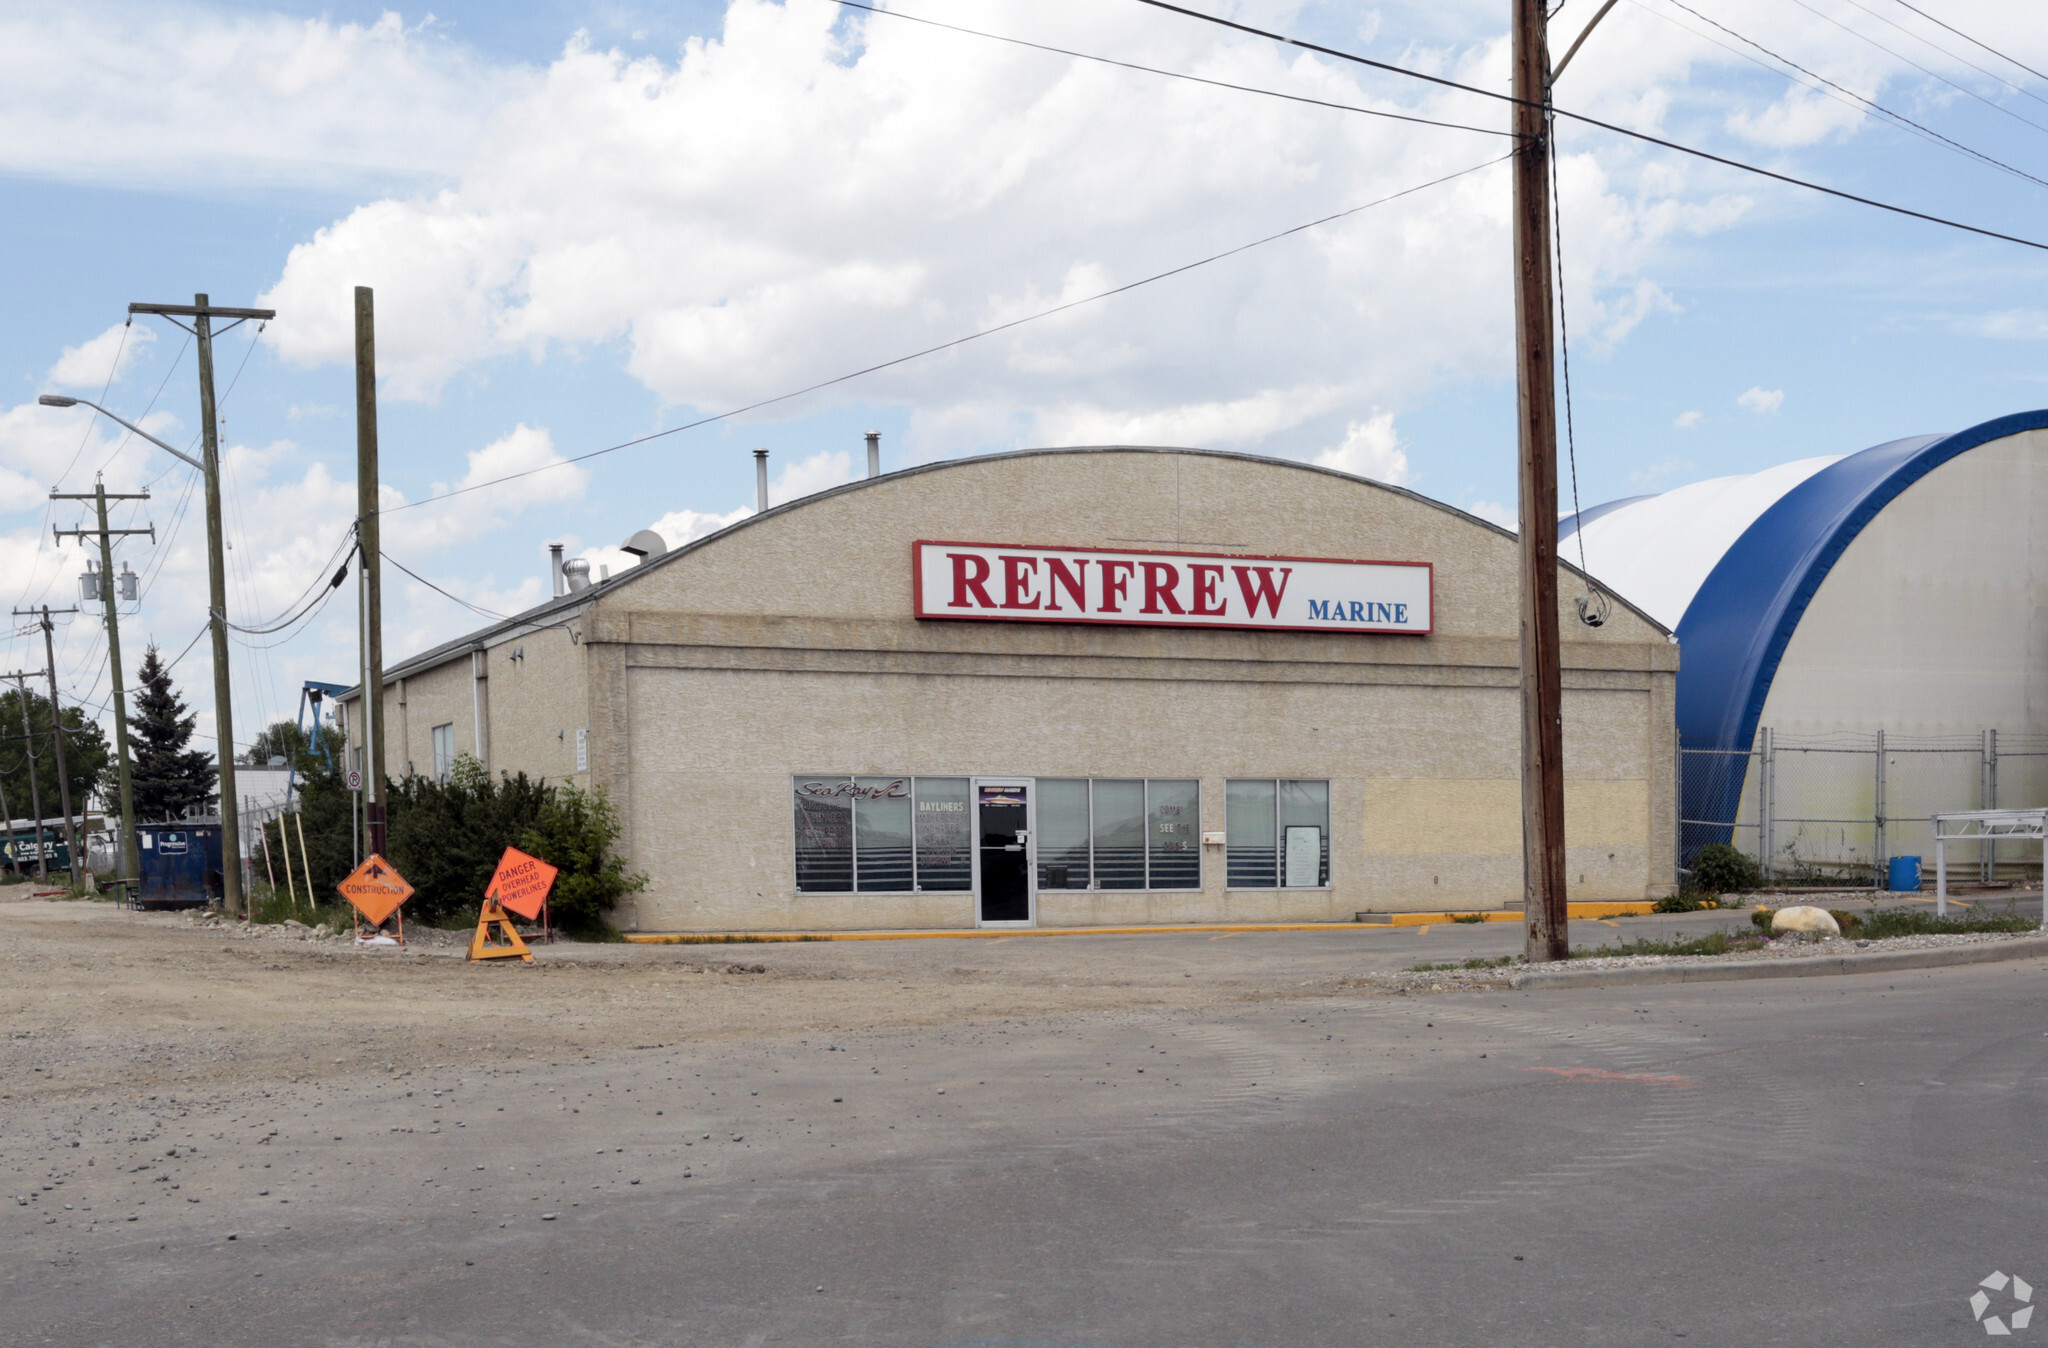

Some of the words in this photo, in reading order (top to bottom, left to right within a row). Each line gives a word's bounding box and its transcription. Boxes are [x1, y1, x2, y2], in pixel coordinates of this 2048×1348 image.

[946, 553, 1292, 619] RENFREW
[1307, 599, 1409, 624] MARINE
[920, 802, 964, 812] BAYLINERS
[1159, 823, 1174, 833] SEE
[498, 860, 536, 881] DANGER
[346, 884, 405, 895] CONSTRUCTION
[501, 880, 548, 903] POWERLINES
[502, 871, 541, 892] OVERHEAD
